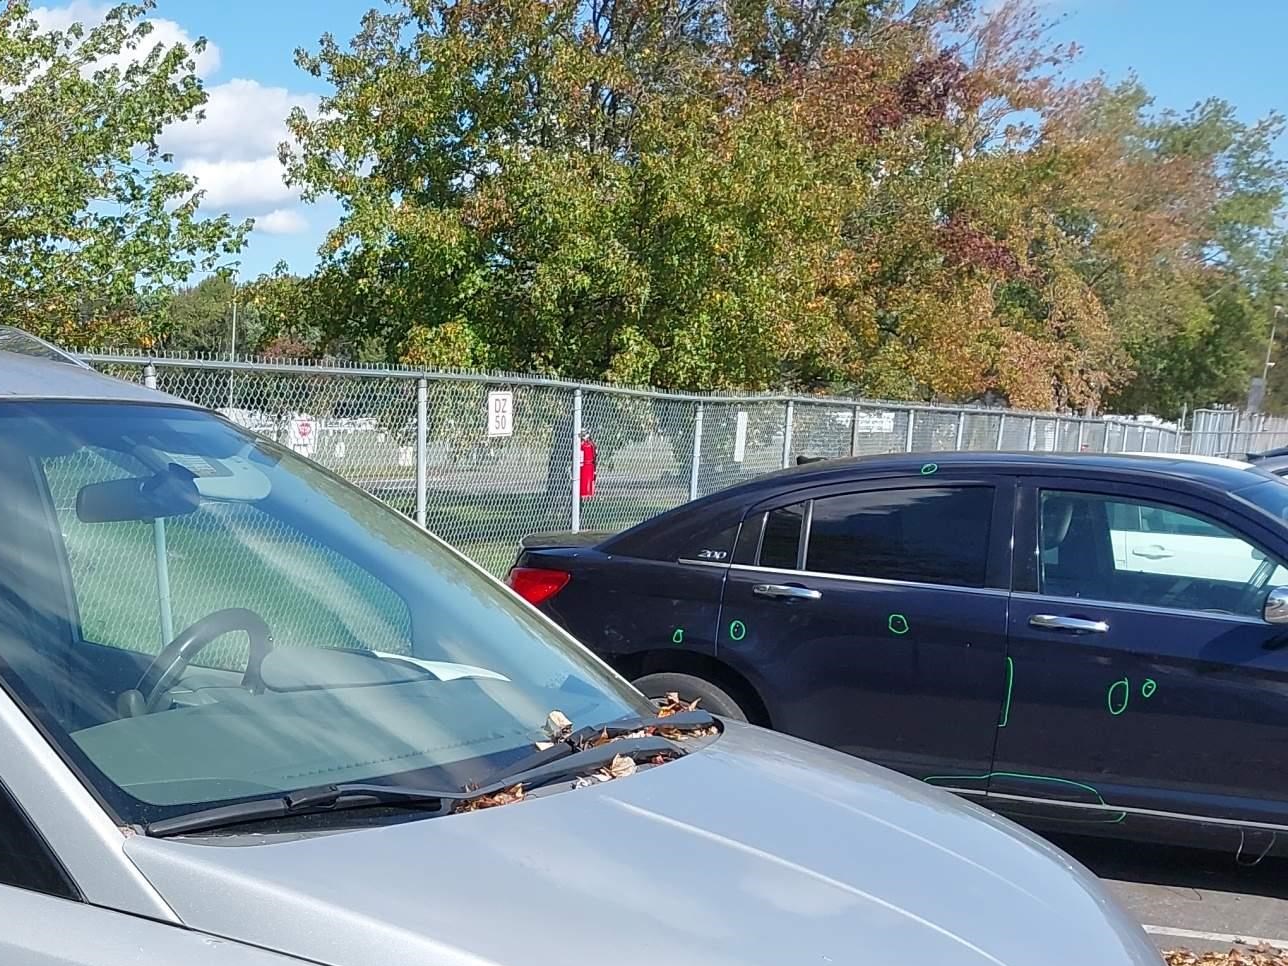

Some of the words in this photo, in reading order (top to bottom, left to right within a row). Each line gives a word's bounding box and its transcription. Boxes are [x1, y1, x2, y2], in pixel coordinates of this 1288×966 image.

[494, 398, 508, 413] DZ
[494, 415, 507, 430] 50
[697, 549, 727, 560] 200
